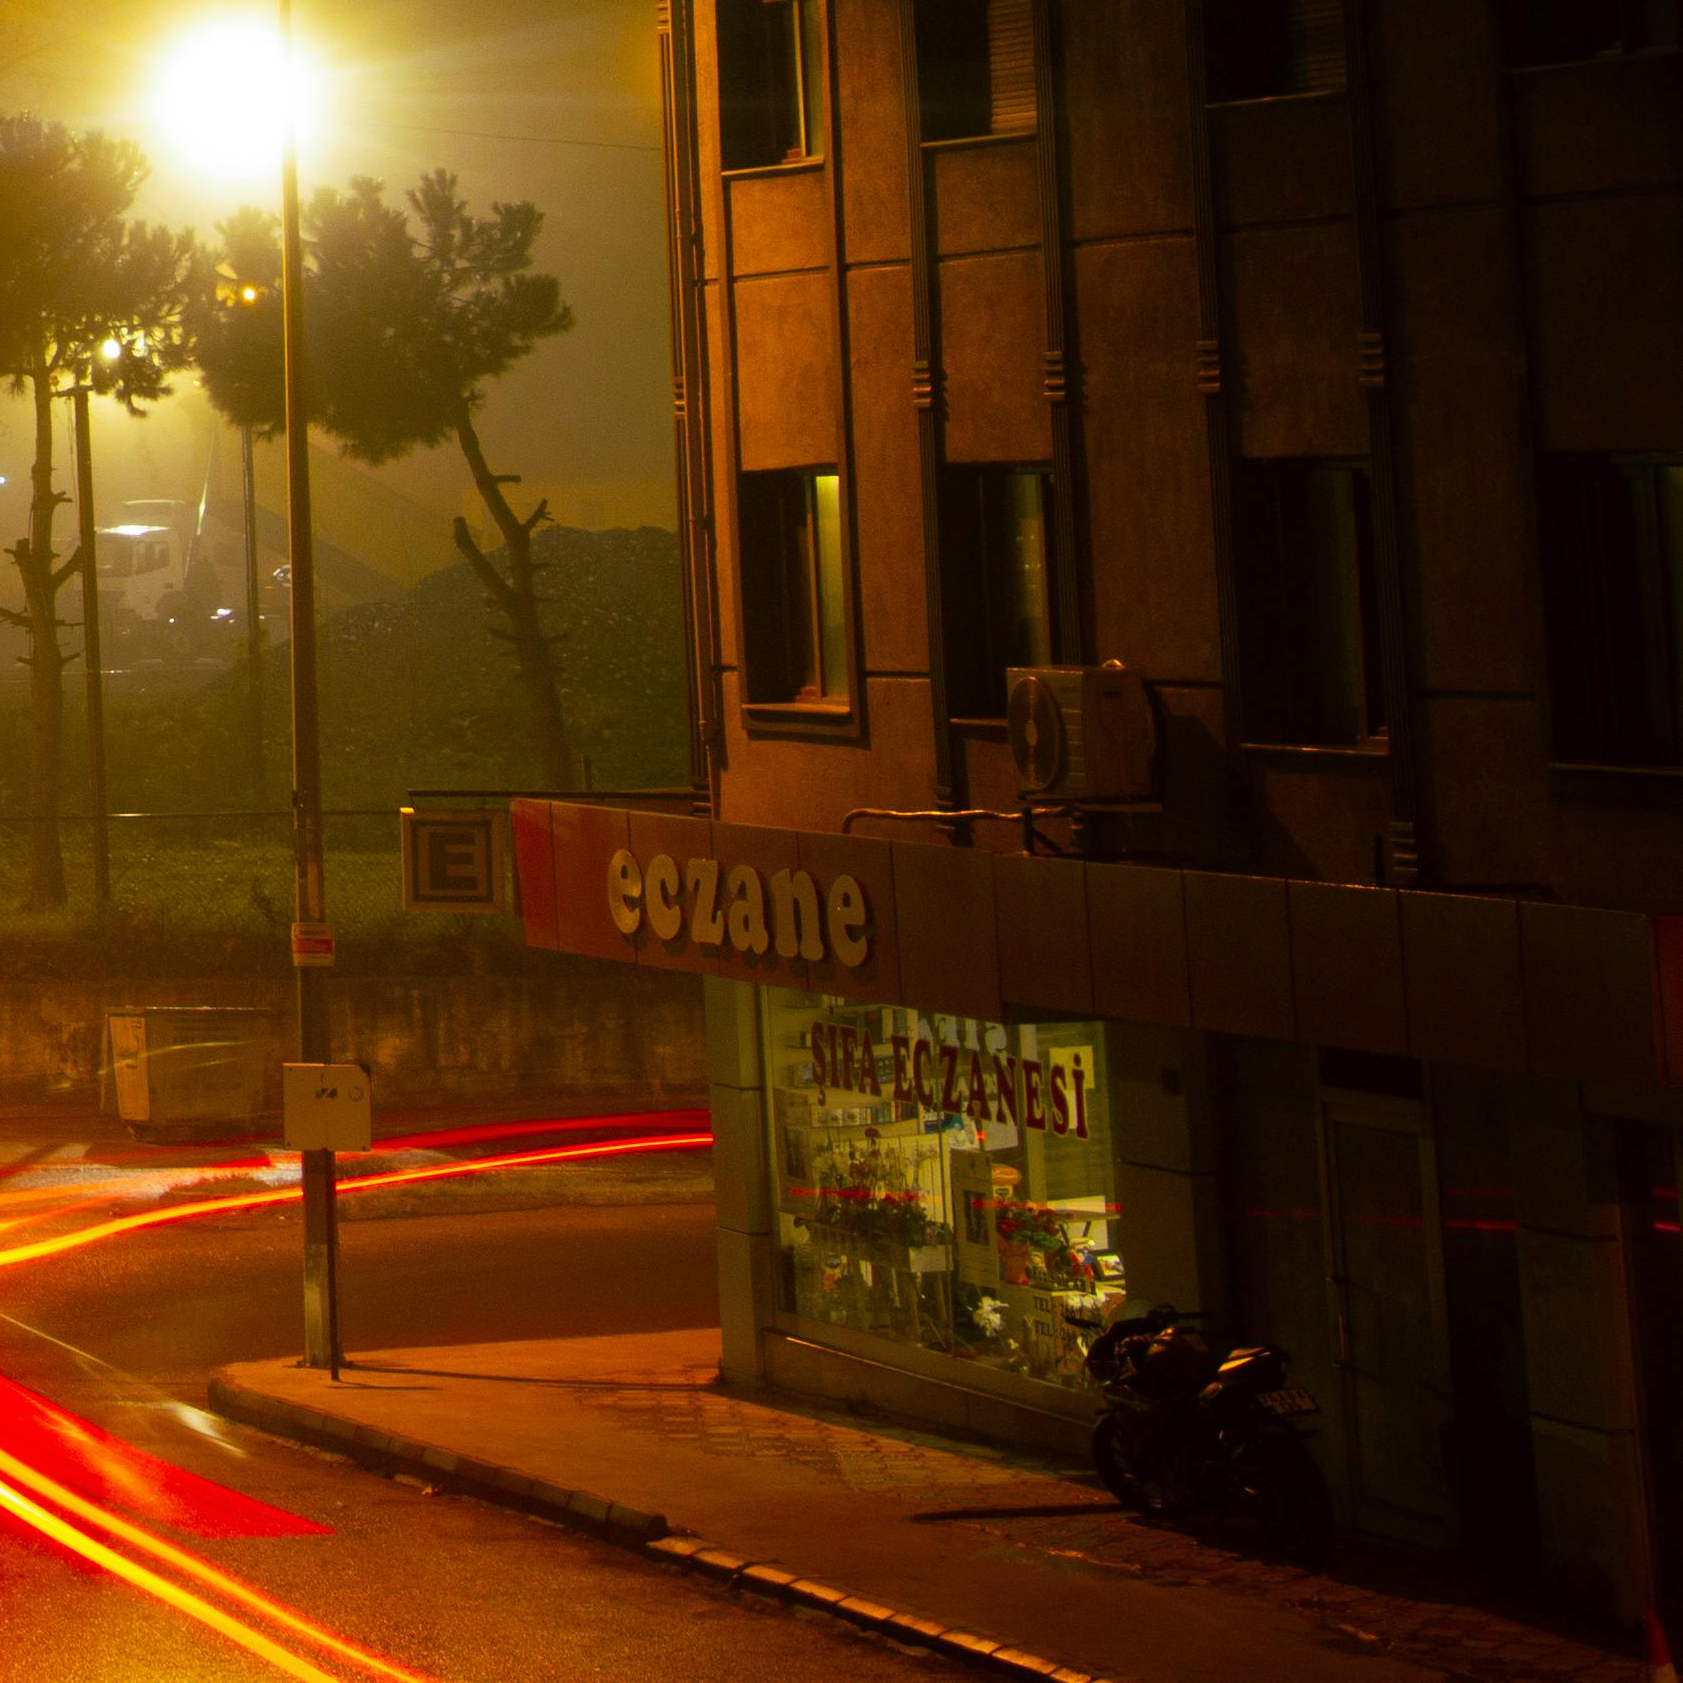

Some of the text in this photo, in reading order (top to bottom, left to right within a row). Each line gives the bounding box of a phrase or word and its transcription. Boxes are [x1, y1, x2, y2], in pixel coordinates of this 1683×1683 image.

[430, 832, 480, 891] E
[607, 849, 868, 967] eczane
[890, 1034, 1089, 1140] ECZANESİ
